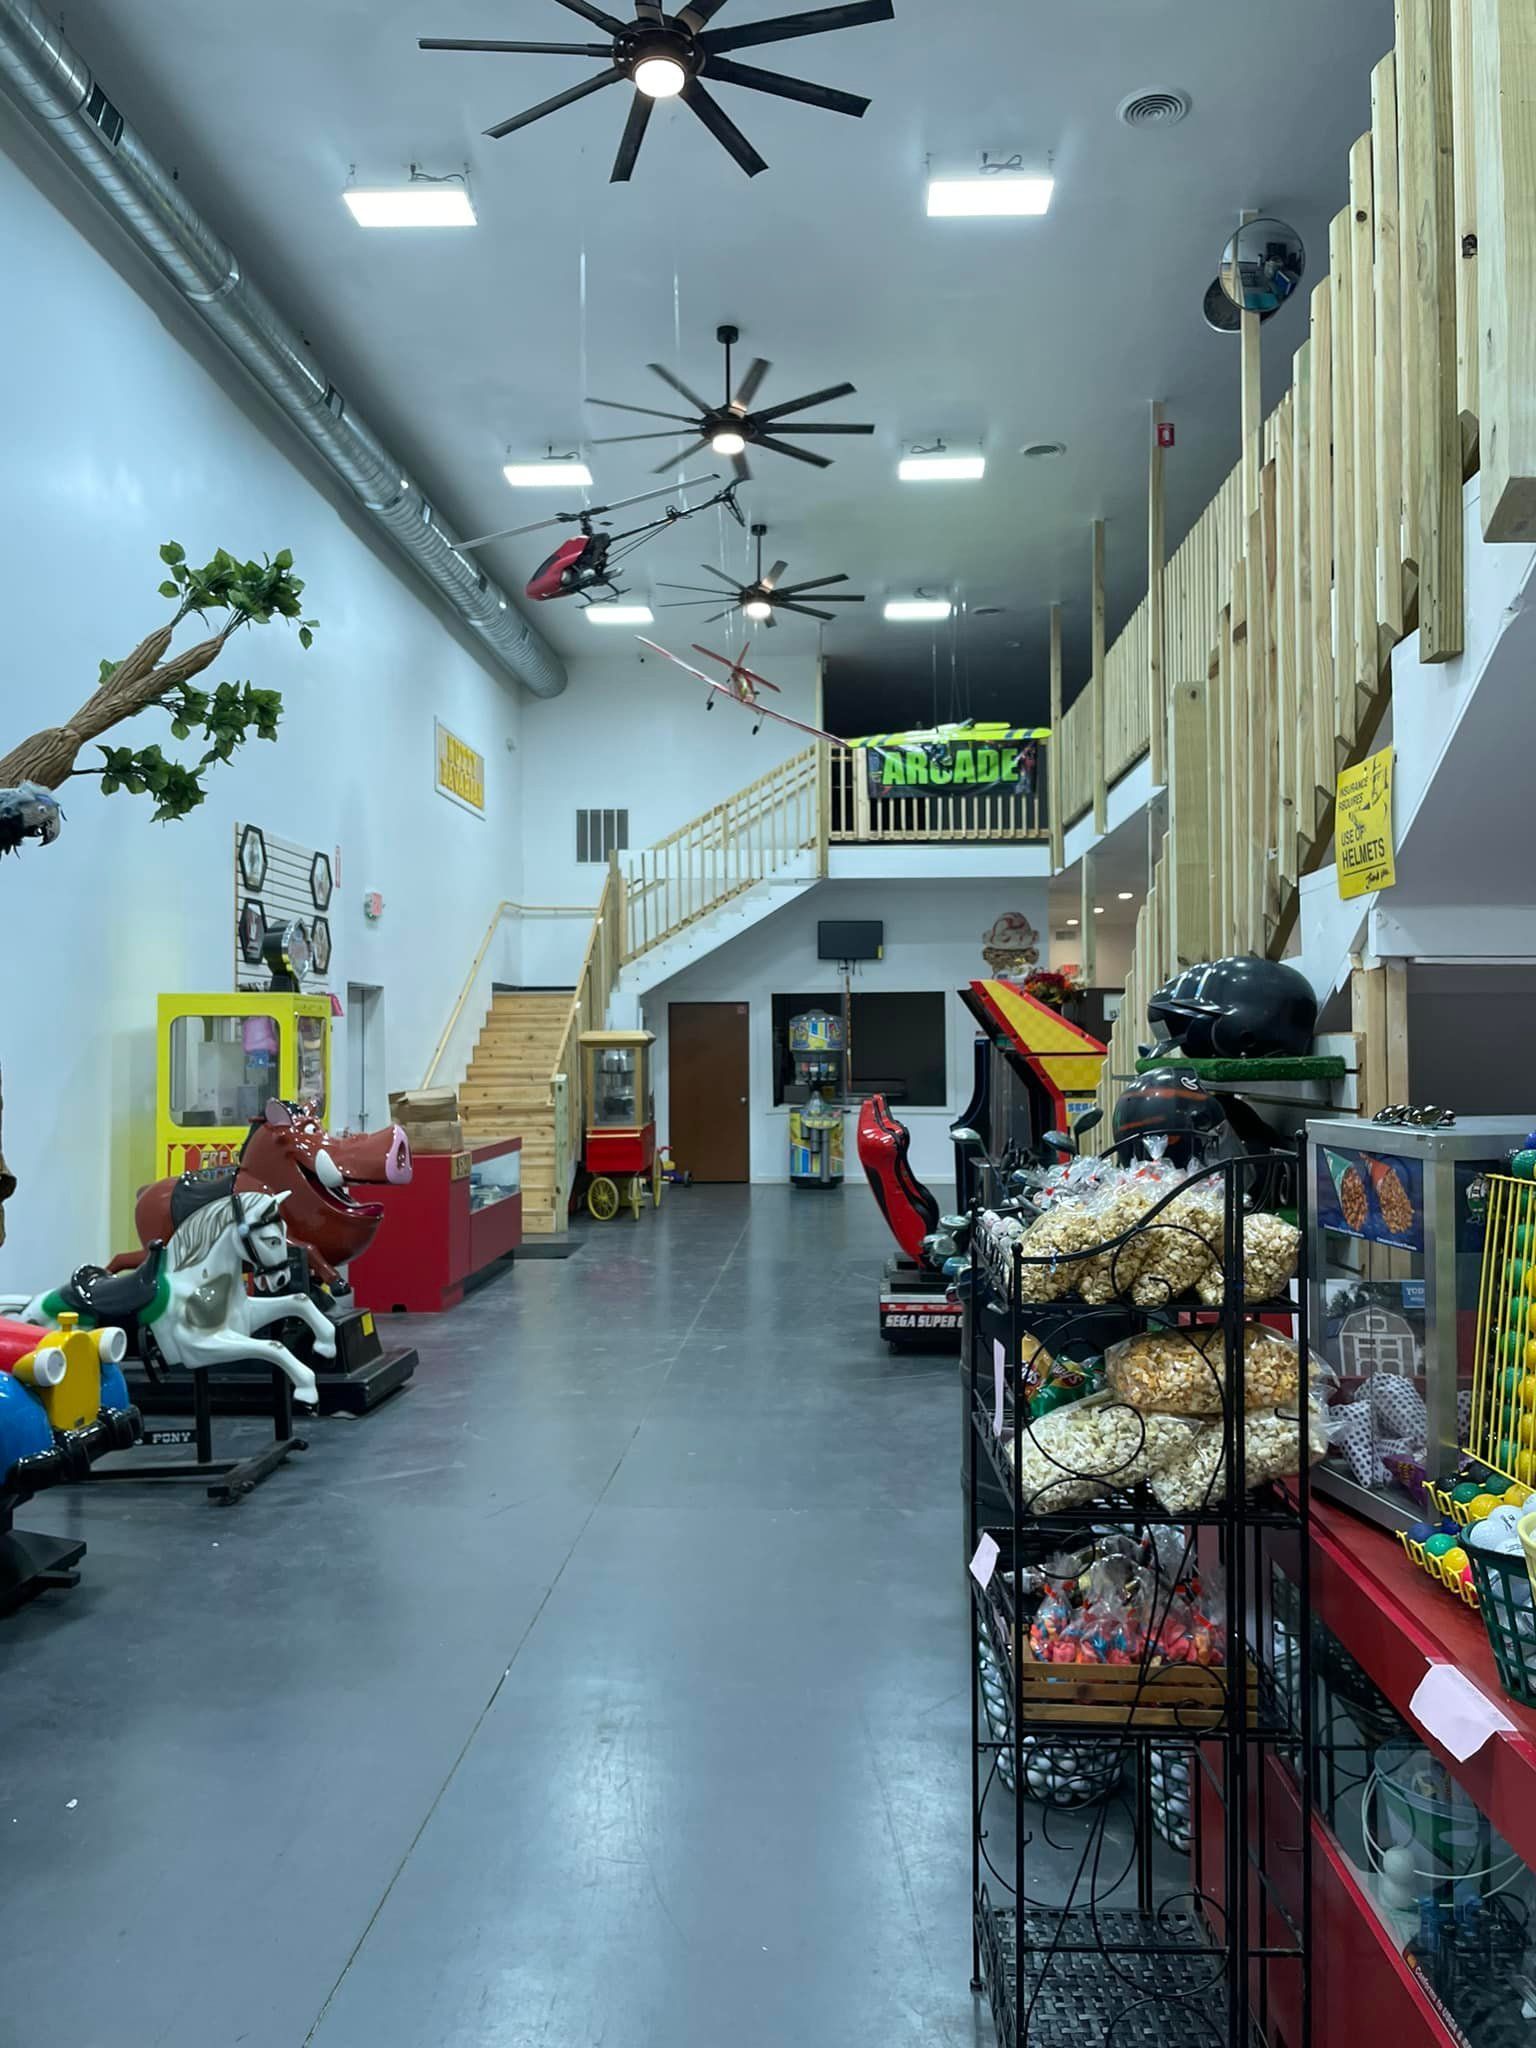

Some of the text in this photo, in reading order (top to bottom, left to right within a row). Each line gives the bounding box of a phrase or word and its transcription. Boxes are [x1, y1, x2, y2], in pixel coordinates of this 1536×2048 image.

[882, 748, 1019, 785] ARCADE
[1341, 776, 1368, 797] INSURANCE
[1341, 824, 1364, 847] USE OF
[1342, 837, 1385, 871] HELMETS
[885, 1315, 915, 1328] SEGA
[917, 1315, 956, 1328] SUPER
[152, 1432, 191, 1444] PONY
